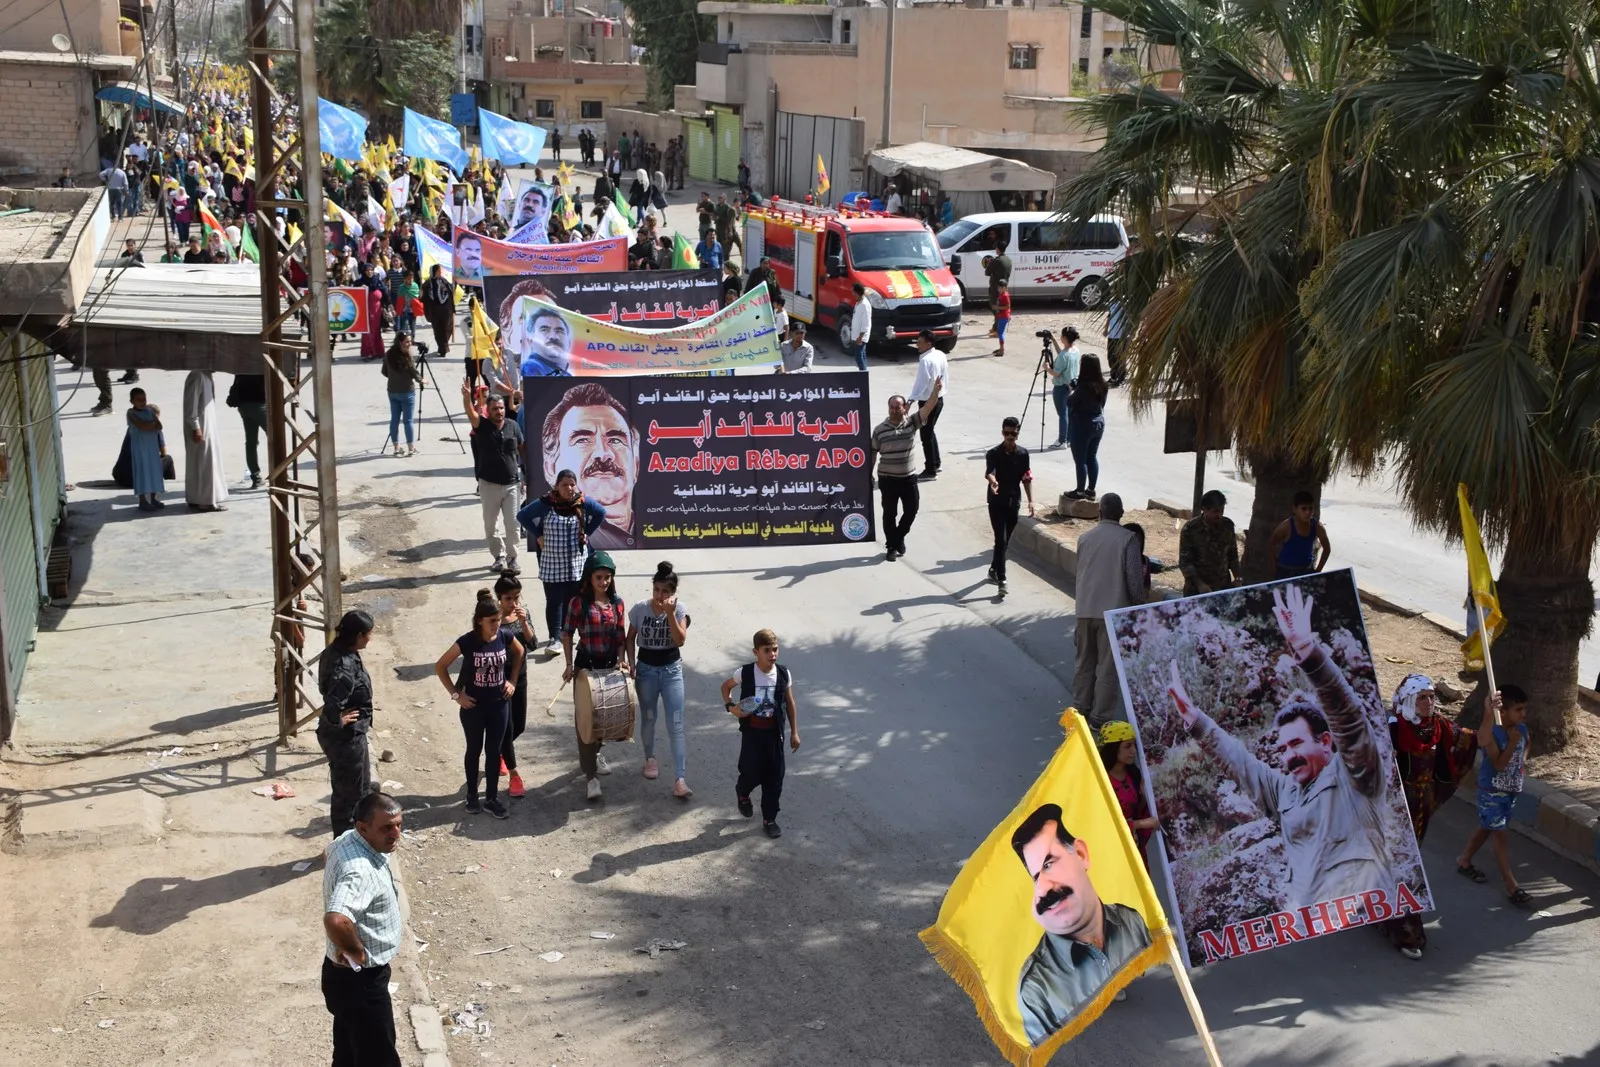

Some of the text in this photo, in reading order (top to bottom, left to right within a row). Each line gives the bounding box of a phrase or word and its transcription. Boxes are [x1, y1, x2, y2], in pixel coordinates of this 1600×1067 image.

[580, 282, 611, 292] القائد
[612, 282, 628, 292] بحق
[630, 280, 661, 292] الدولية
[587, 342, 616, 351] APO
[618, 342, 649, 352] القائد
[651, 343, 678, 355] يعيش
[662, 390, 704, 402] القائد
[708, 390, 730, 403] بحق
[733, 388, 776, 403] الدولية
[779, 388, 825, 402] المؤامرة
[828, 388, 861, 399] تسقط
[715, 411, 794, 437] للقائد
[797, 410, 859, 441] الحرية
[648, 448, 866, 476] Azadiya Rêber APO
[673, 484, 726, 498] الانسانية
[728, 483, 758, 498] حرية
[781, 482, 813, 494] القائد
[817, 482, 846, 496] حرية
[642, 524, 681, 538] بالحسكة
[683, 524, 721, 539] الشرقية
[723, 522, 759, 537] الناحية
[760, 522, 772, 540] في
[773, 522, 808, 535] الشعب
[809, 520, 835, 534] بلدية
[653, 628, 671, 638] THE
[1198, 882, 1424, 964] MERHEBA
